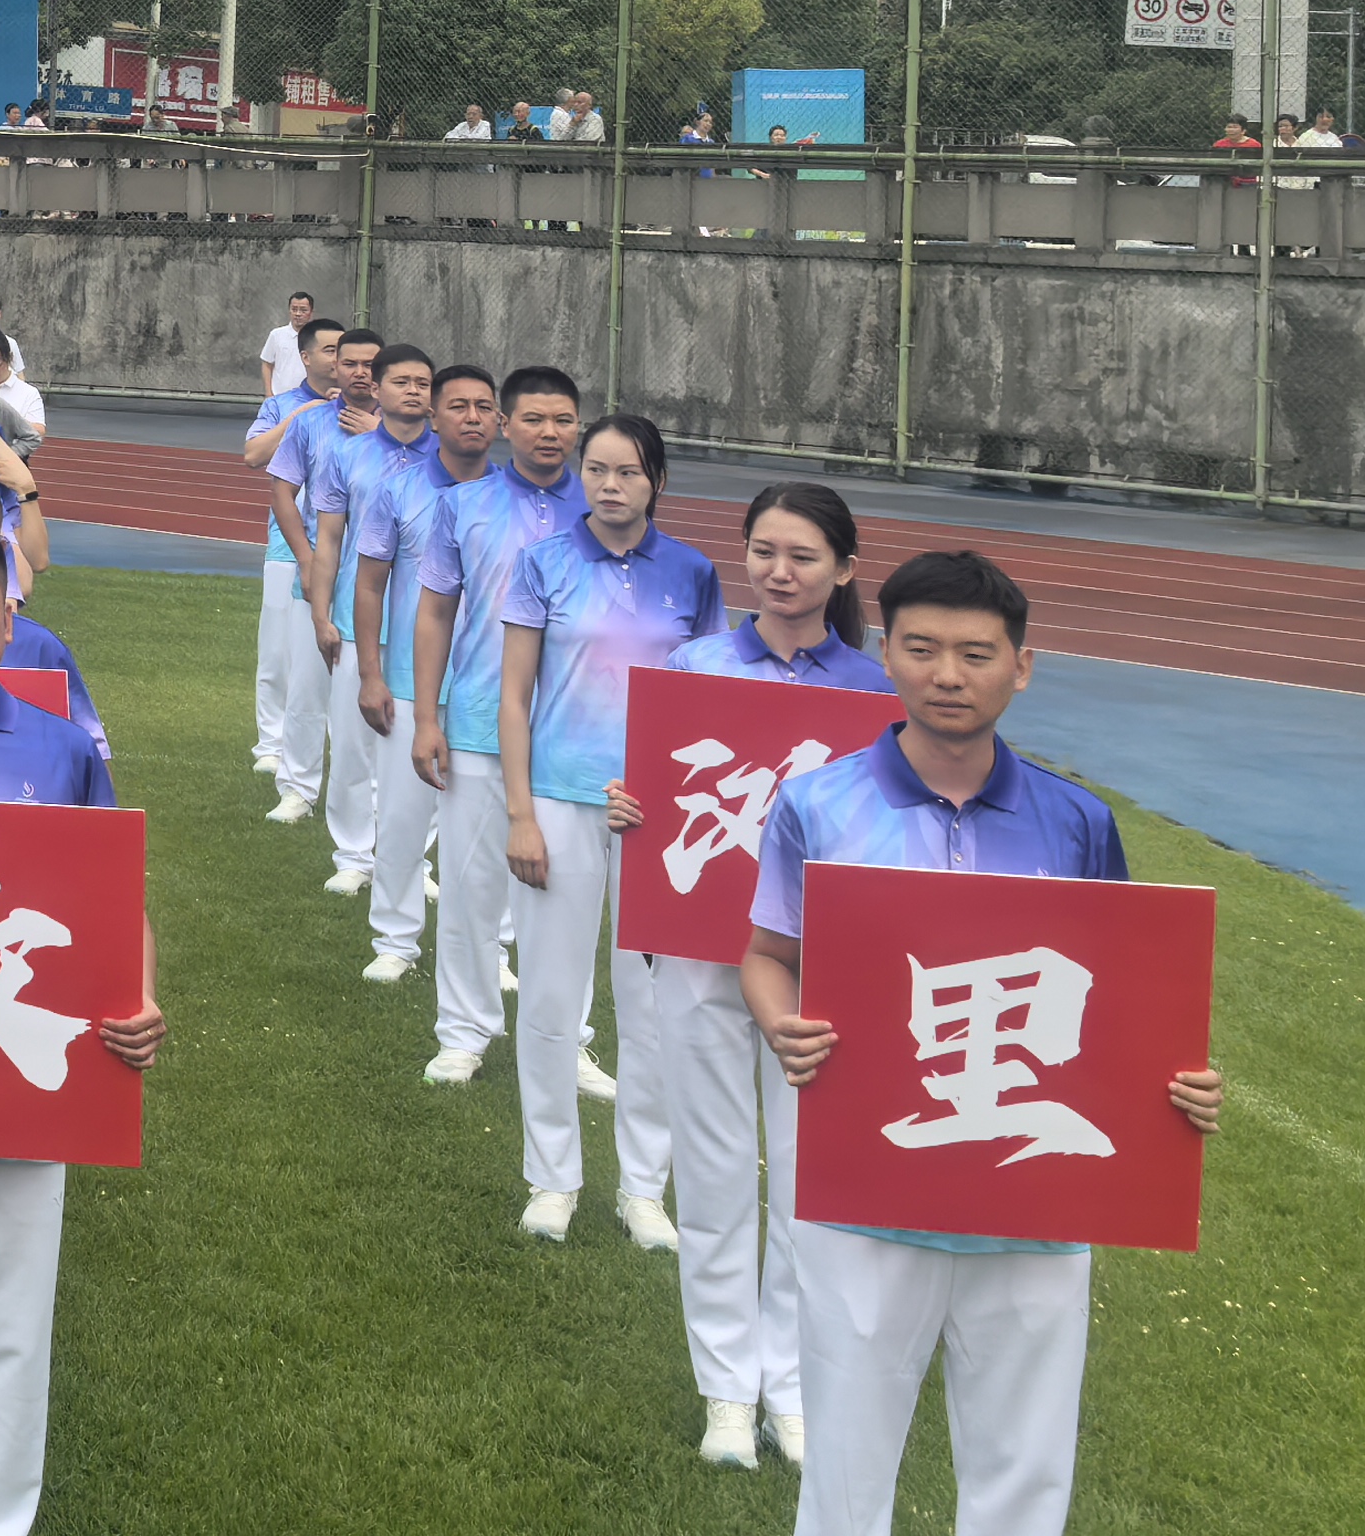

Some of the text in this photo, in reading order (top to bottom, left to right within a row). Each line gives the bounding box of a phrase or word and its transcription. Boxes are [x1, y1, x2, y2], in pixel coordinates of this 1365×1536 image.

[281, 75, 331, 107] 铺租售
[880, 946, 1118, 1168] 里
